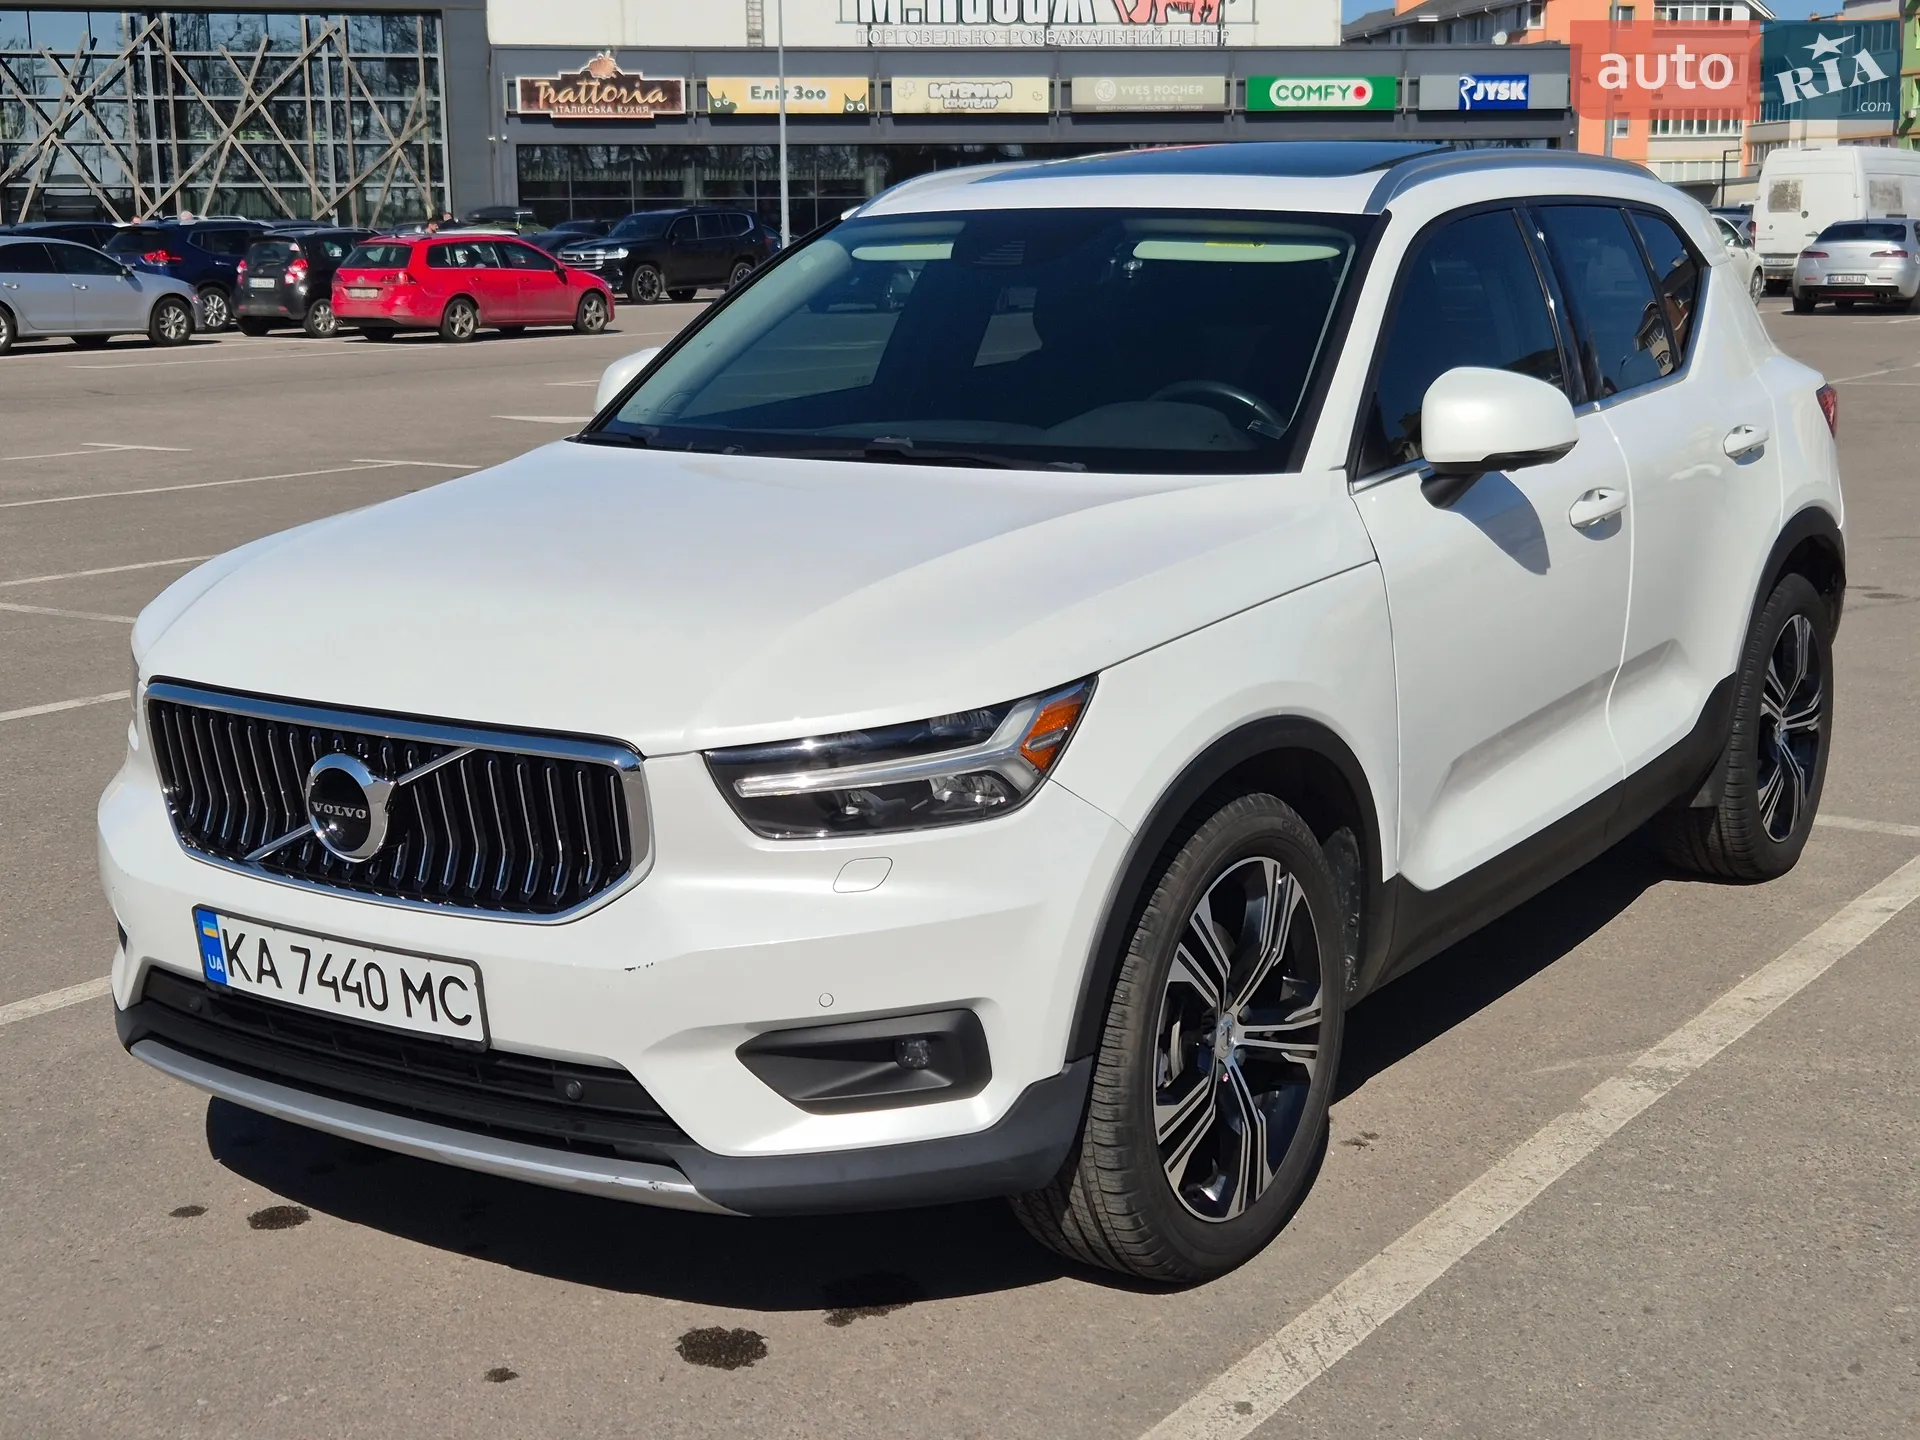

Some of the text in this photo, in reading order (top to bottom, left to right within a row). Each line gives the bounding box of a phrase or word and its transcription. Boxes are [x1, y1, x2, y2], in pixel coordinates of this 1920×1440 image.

[1169, 28, 1230, 46] ЦЕНТР
[535, 79, 667, 109] Trattoria
[1120, 85, 1204, 96] YVES ROCHER
[1275, 84, 1351, 101] COMFY
[1472, 80, 1527, 101] JYSK
[555, 105, 649, 114] ІТАЛІЙСЬКА КУХНЯ
[312, 801, 367, 819] VOLVO
[207, 953, 224, 973] UA
[222, 928, 472, 1026] KA 7440 MC
